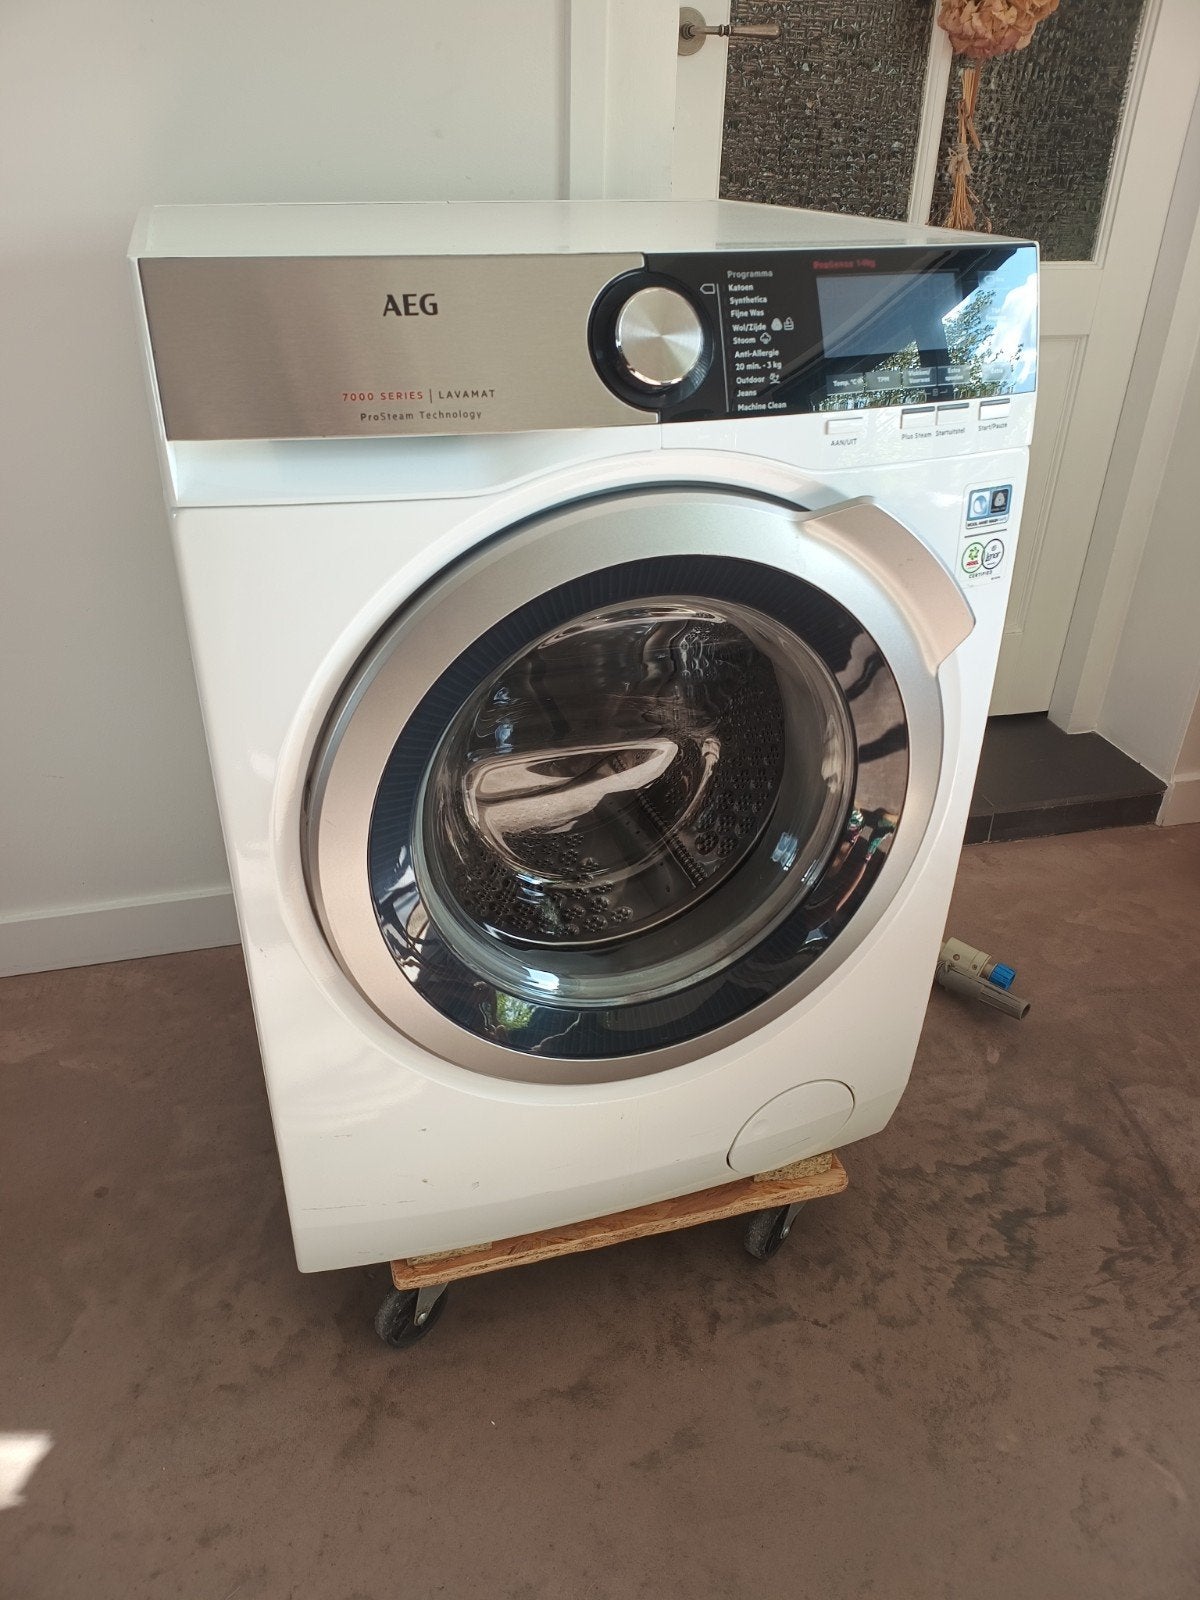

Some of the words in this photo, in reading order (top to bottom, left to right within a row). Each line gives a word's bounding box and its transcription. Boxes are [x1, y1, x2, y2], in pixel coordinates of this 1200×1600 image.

[727, 270, 773, 279] Programma
[383, 293, 438, 317] AEG
[730, 310, 748, 318] Fijne
[749, 309, 764, 317] Was
[732, 323, 766, 332] Wol/Zijde
[735, 349, 779, 358] Anti-Allergie
[736, 376, 765, 384] Outdoor
[342, 392, 374, 401] 7000
[380, 391, 424, 400] SERIES
[438, 389, 496, 399] LAVAMAT
[738, 402, 766, 411] Machine
[768, 401, 787, 409] Clean
[360, 411, 414, 421] ProSteam
[419, 410, 482, 421] Technology
